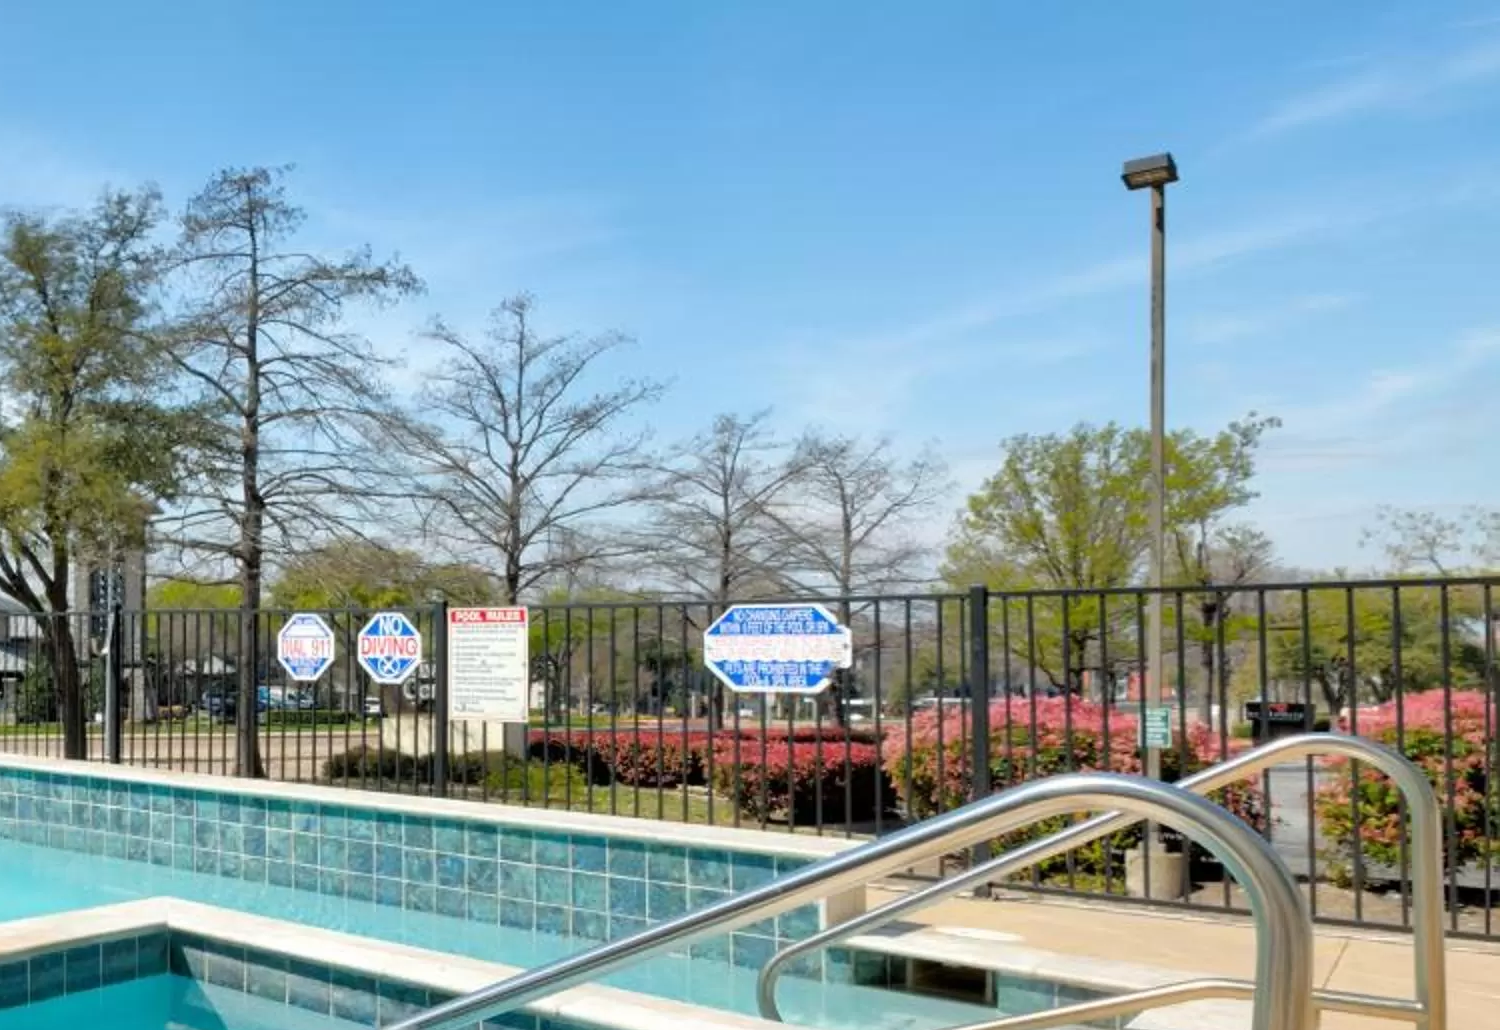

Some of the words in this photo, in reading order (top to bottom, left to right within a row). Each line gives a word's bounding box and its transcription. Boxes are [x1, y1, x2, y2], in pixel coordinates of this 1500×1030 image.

[379, 615, 403, 636] NO
[455, 610, 482, 623] POOL
[485, 610, 522, 622] RULES
[282, 638, 307, 657] DIAL
[311, 638, 331, 657] 911
[361, 636, 417, 656] DIVING
